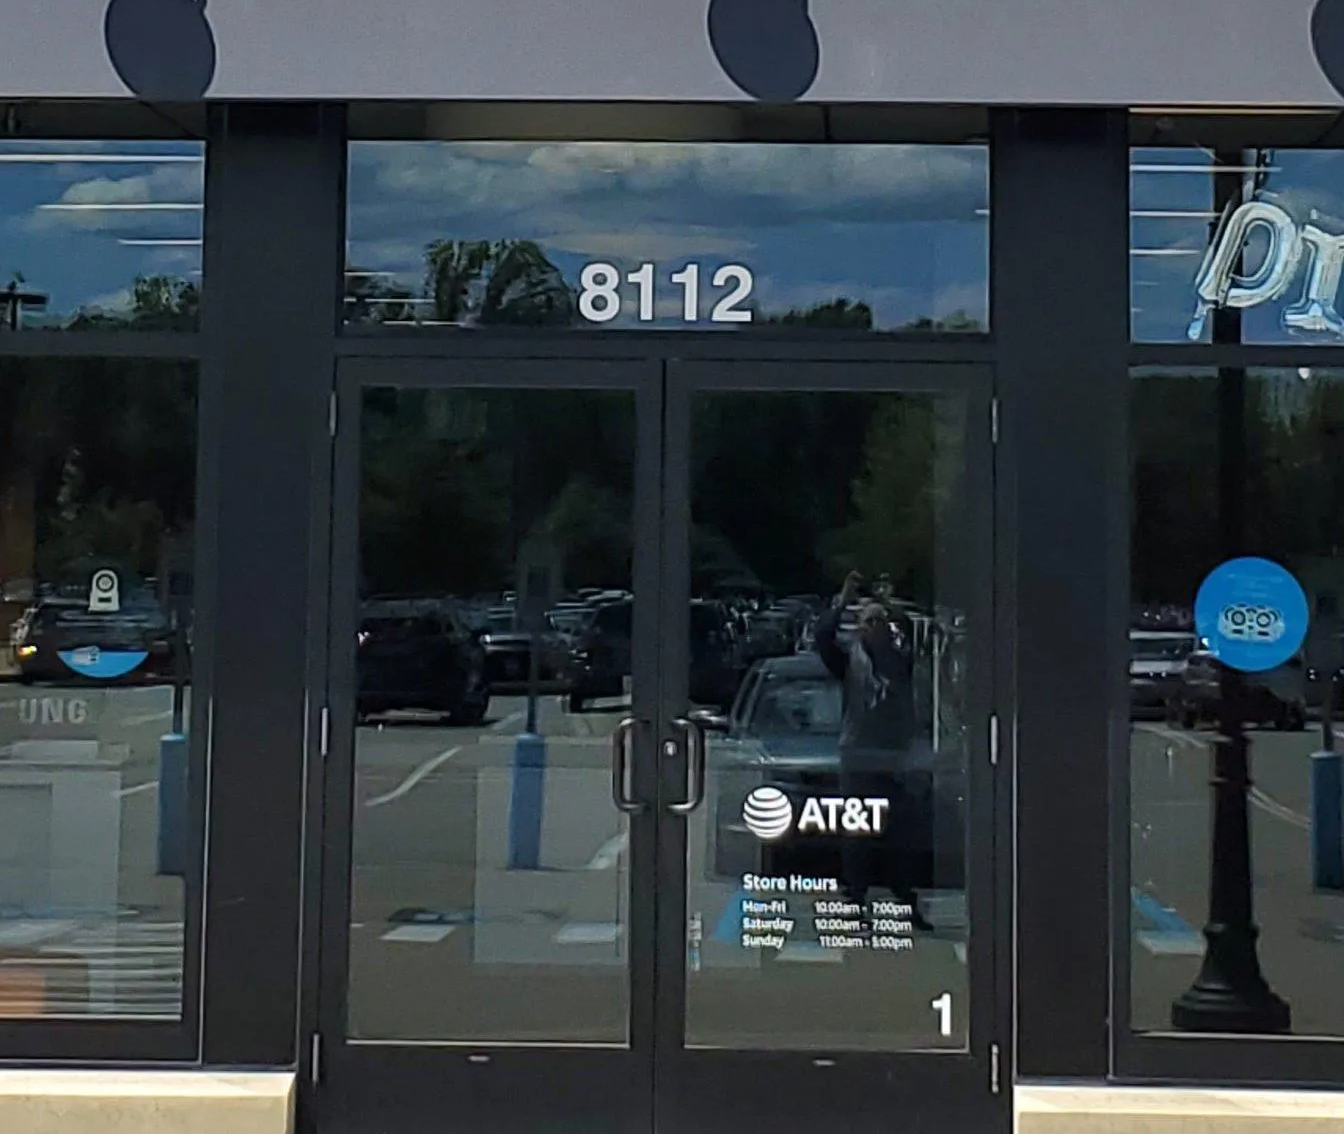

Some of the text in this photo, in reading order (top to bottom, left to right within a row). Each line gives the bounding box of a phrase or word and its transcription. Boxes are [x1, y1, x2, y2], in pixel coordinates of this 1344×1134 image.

[579, 263, 753, 322] 8112
[798, 798, 889, 833] AT&T
[743, 874, 838, 891] Store Hours
[742, 900, 786, 913] Mon-Fri
[814, 901, 859, 914] 10:00am
[872, 902, 912, 916] 7:00pm
[742, 918, 794, 932] Saturday
[814, 919, 859, 931] 10:00am
[872, 919, 912, 934] 7:00pm
[742, 934, 784, 948] Sunday
[932, 993, 951, 1036] 1
